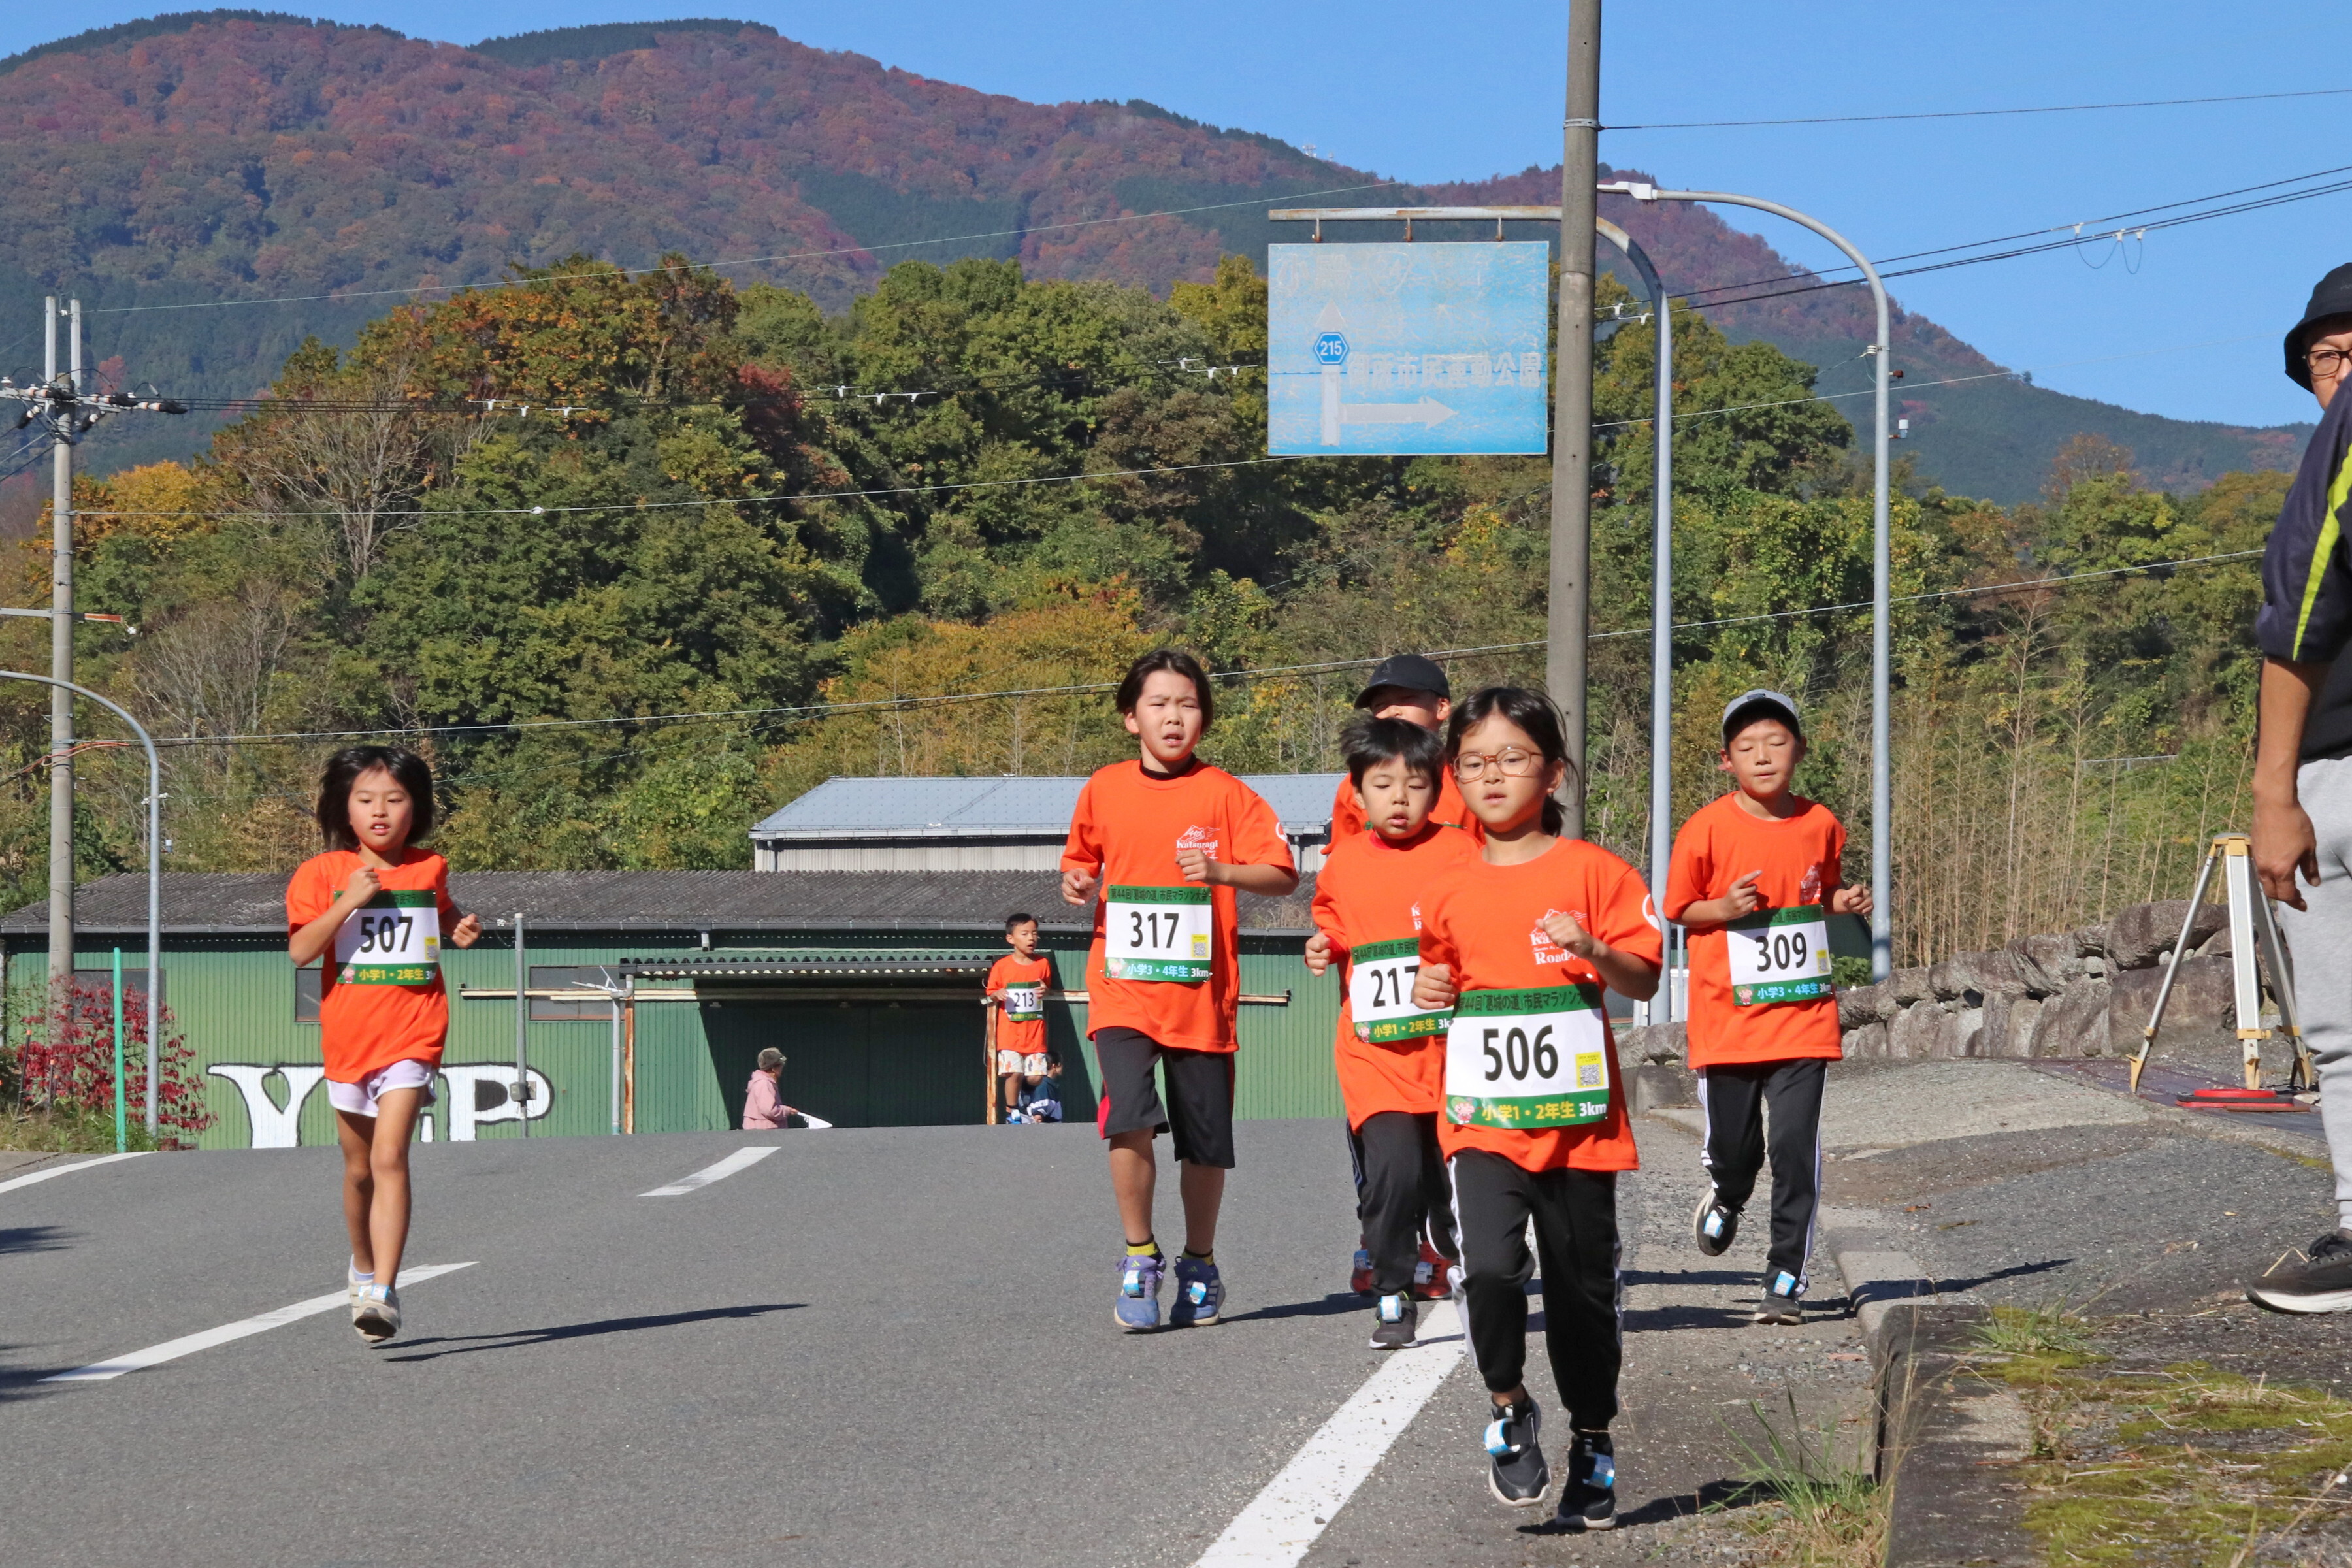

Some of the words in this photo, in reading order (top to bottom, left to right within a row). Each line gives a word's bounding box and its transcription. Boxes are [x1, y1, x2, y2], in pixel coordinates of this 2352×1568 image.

[1320, 340, 1342, 356] 215
[1176, 840, 1218, 849] Katsuragi
[361, 916, 413, 953] 507
[1130, 911, 1179, 949] 317
[1534, 949, 1570, 965] Road
[1756, 932, 1806, 972] 309
[1190, 968, 1209, 977] 3km
[1013, 992, 1034, 1007] 213
[1438, 1018, 1453, 1030] 3k
[1482, 1024, 1559, 1081] 506
[1579, 1102, 1607, 1117] 3km
